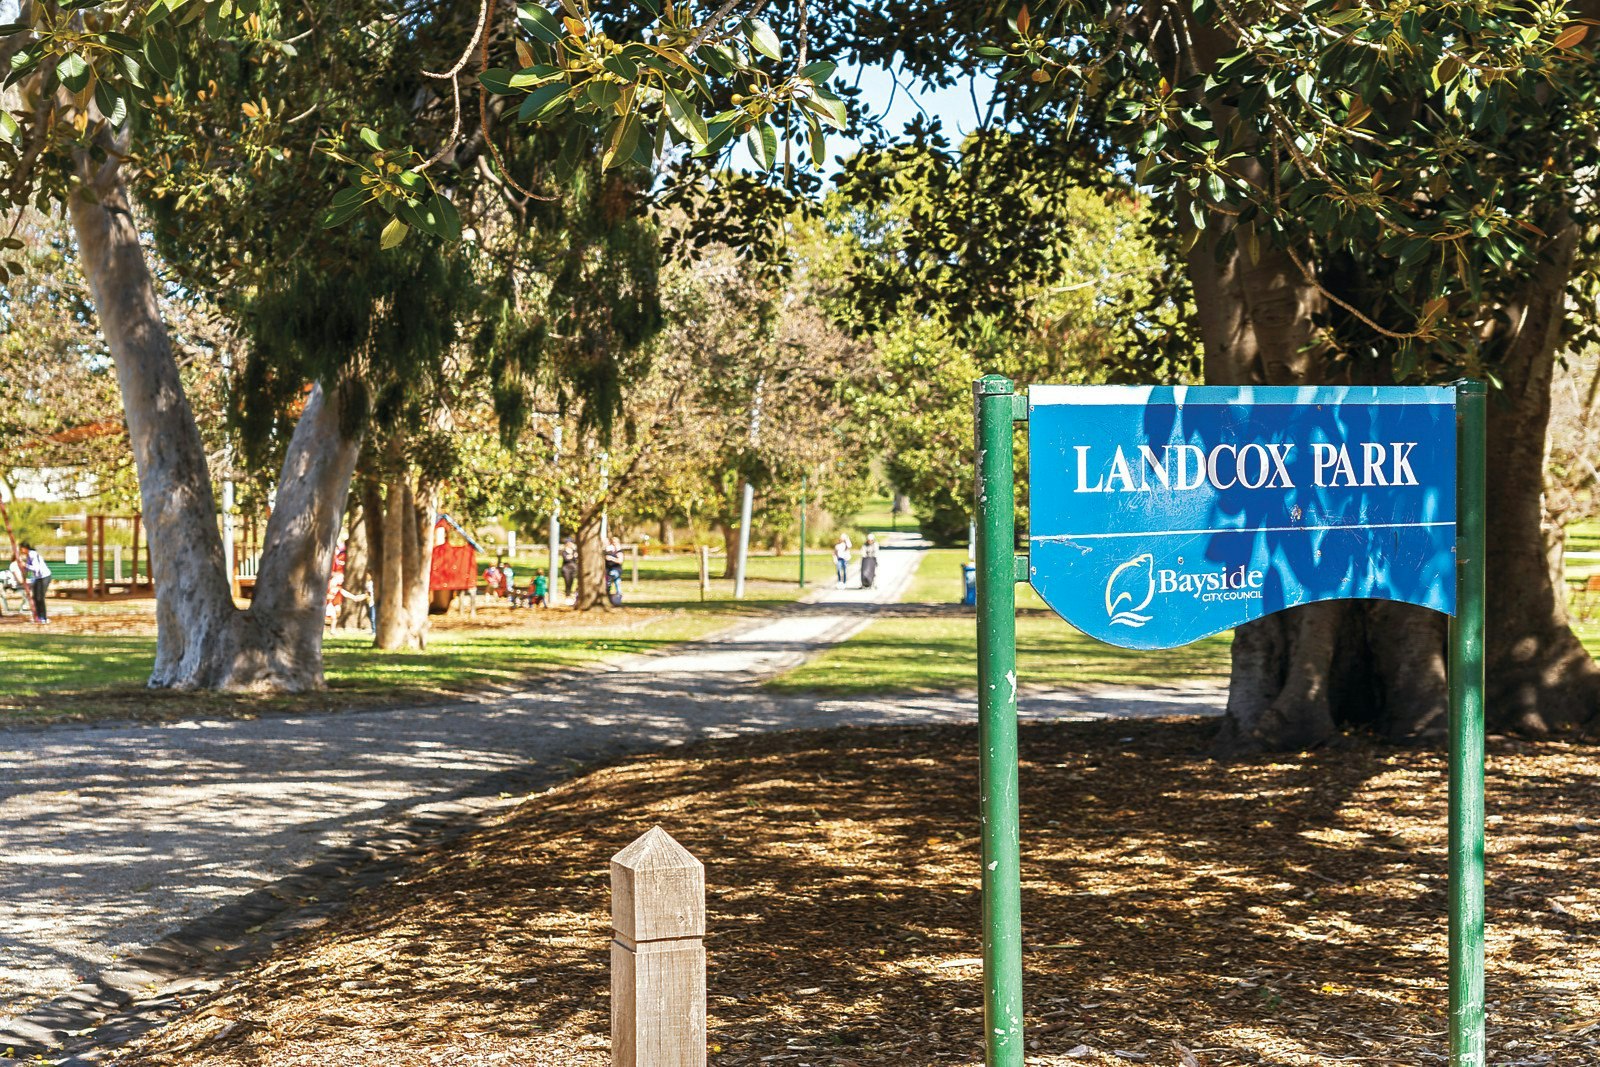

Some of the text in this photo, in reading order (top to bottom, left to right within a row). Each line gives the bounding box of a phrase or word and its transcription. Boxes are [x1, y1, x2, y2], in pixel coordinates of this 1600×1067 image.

[1073, 442, 1420, 494] LANDCOX PARK
[1157, 564, 1264, 598] Bayside
[1202, 590, 1263, 602] CITY COUNCIL
